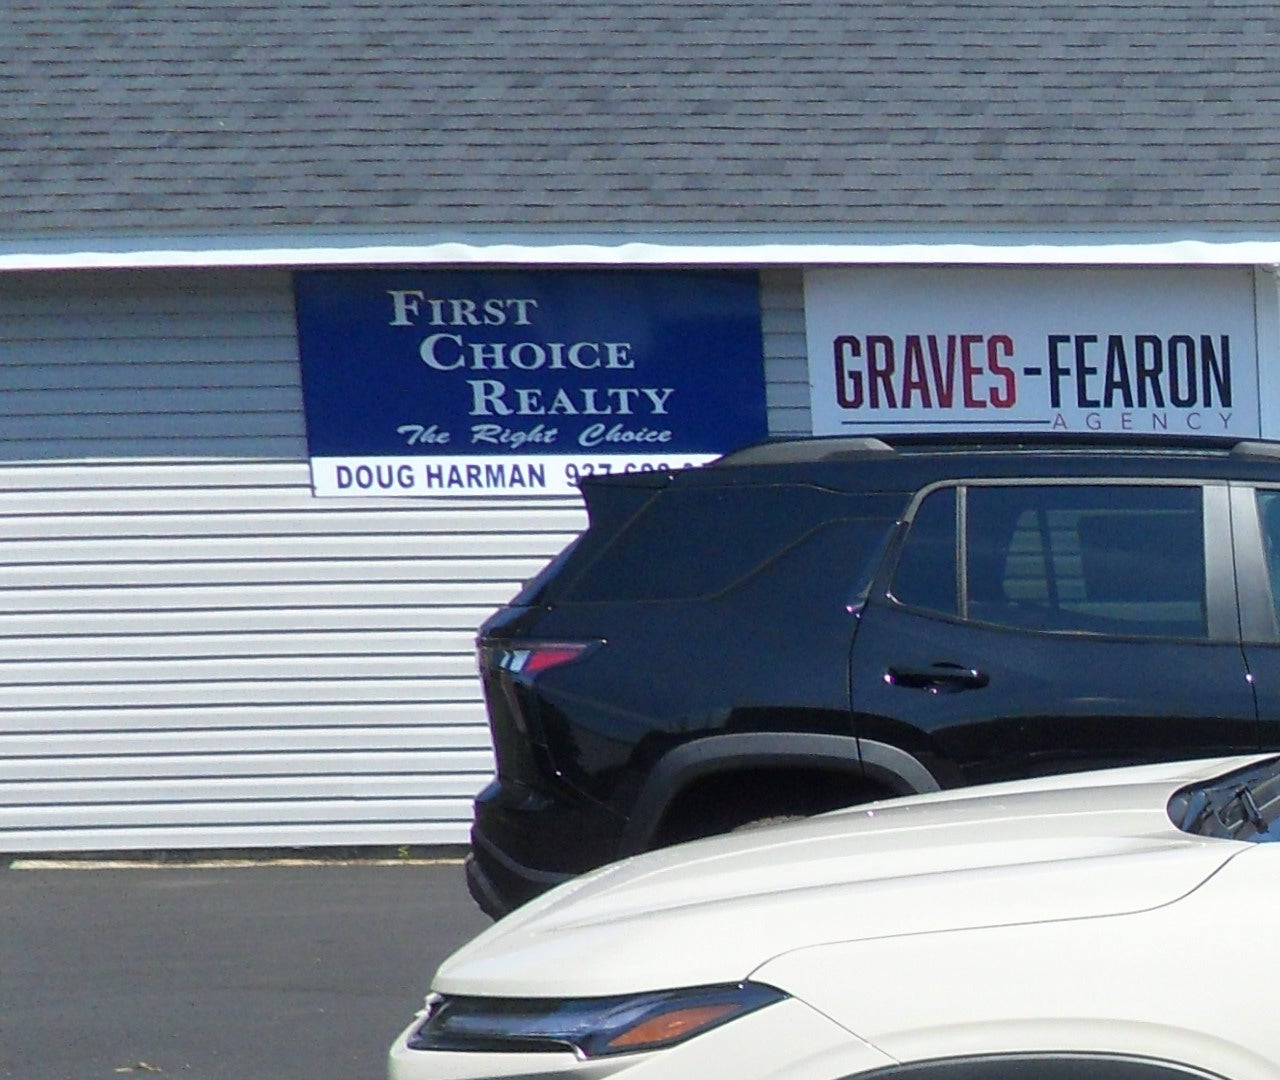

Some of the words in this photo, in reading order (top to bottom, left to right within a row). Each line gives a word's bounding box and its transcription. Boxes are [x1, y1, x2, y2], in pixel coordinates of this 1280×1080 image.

[386, 289, 539, 327] FIRST
[419, 332, 635, 370] CHOICE
[833, 334, 1233, 409] GRAVES-FEARON
[466, 379, 675, 416] REALTY
[397, 424, 451, 446] The
[471, 424, 559, 450] Right
[578, 423, 673, 448] Choice
[1052, 412, 1233, 431] AGENCY
[336, 465, 415, 489] DOUG
[426, 463, 546, 489] HARMAN
